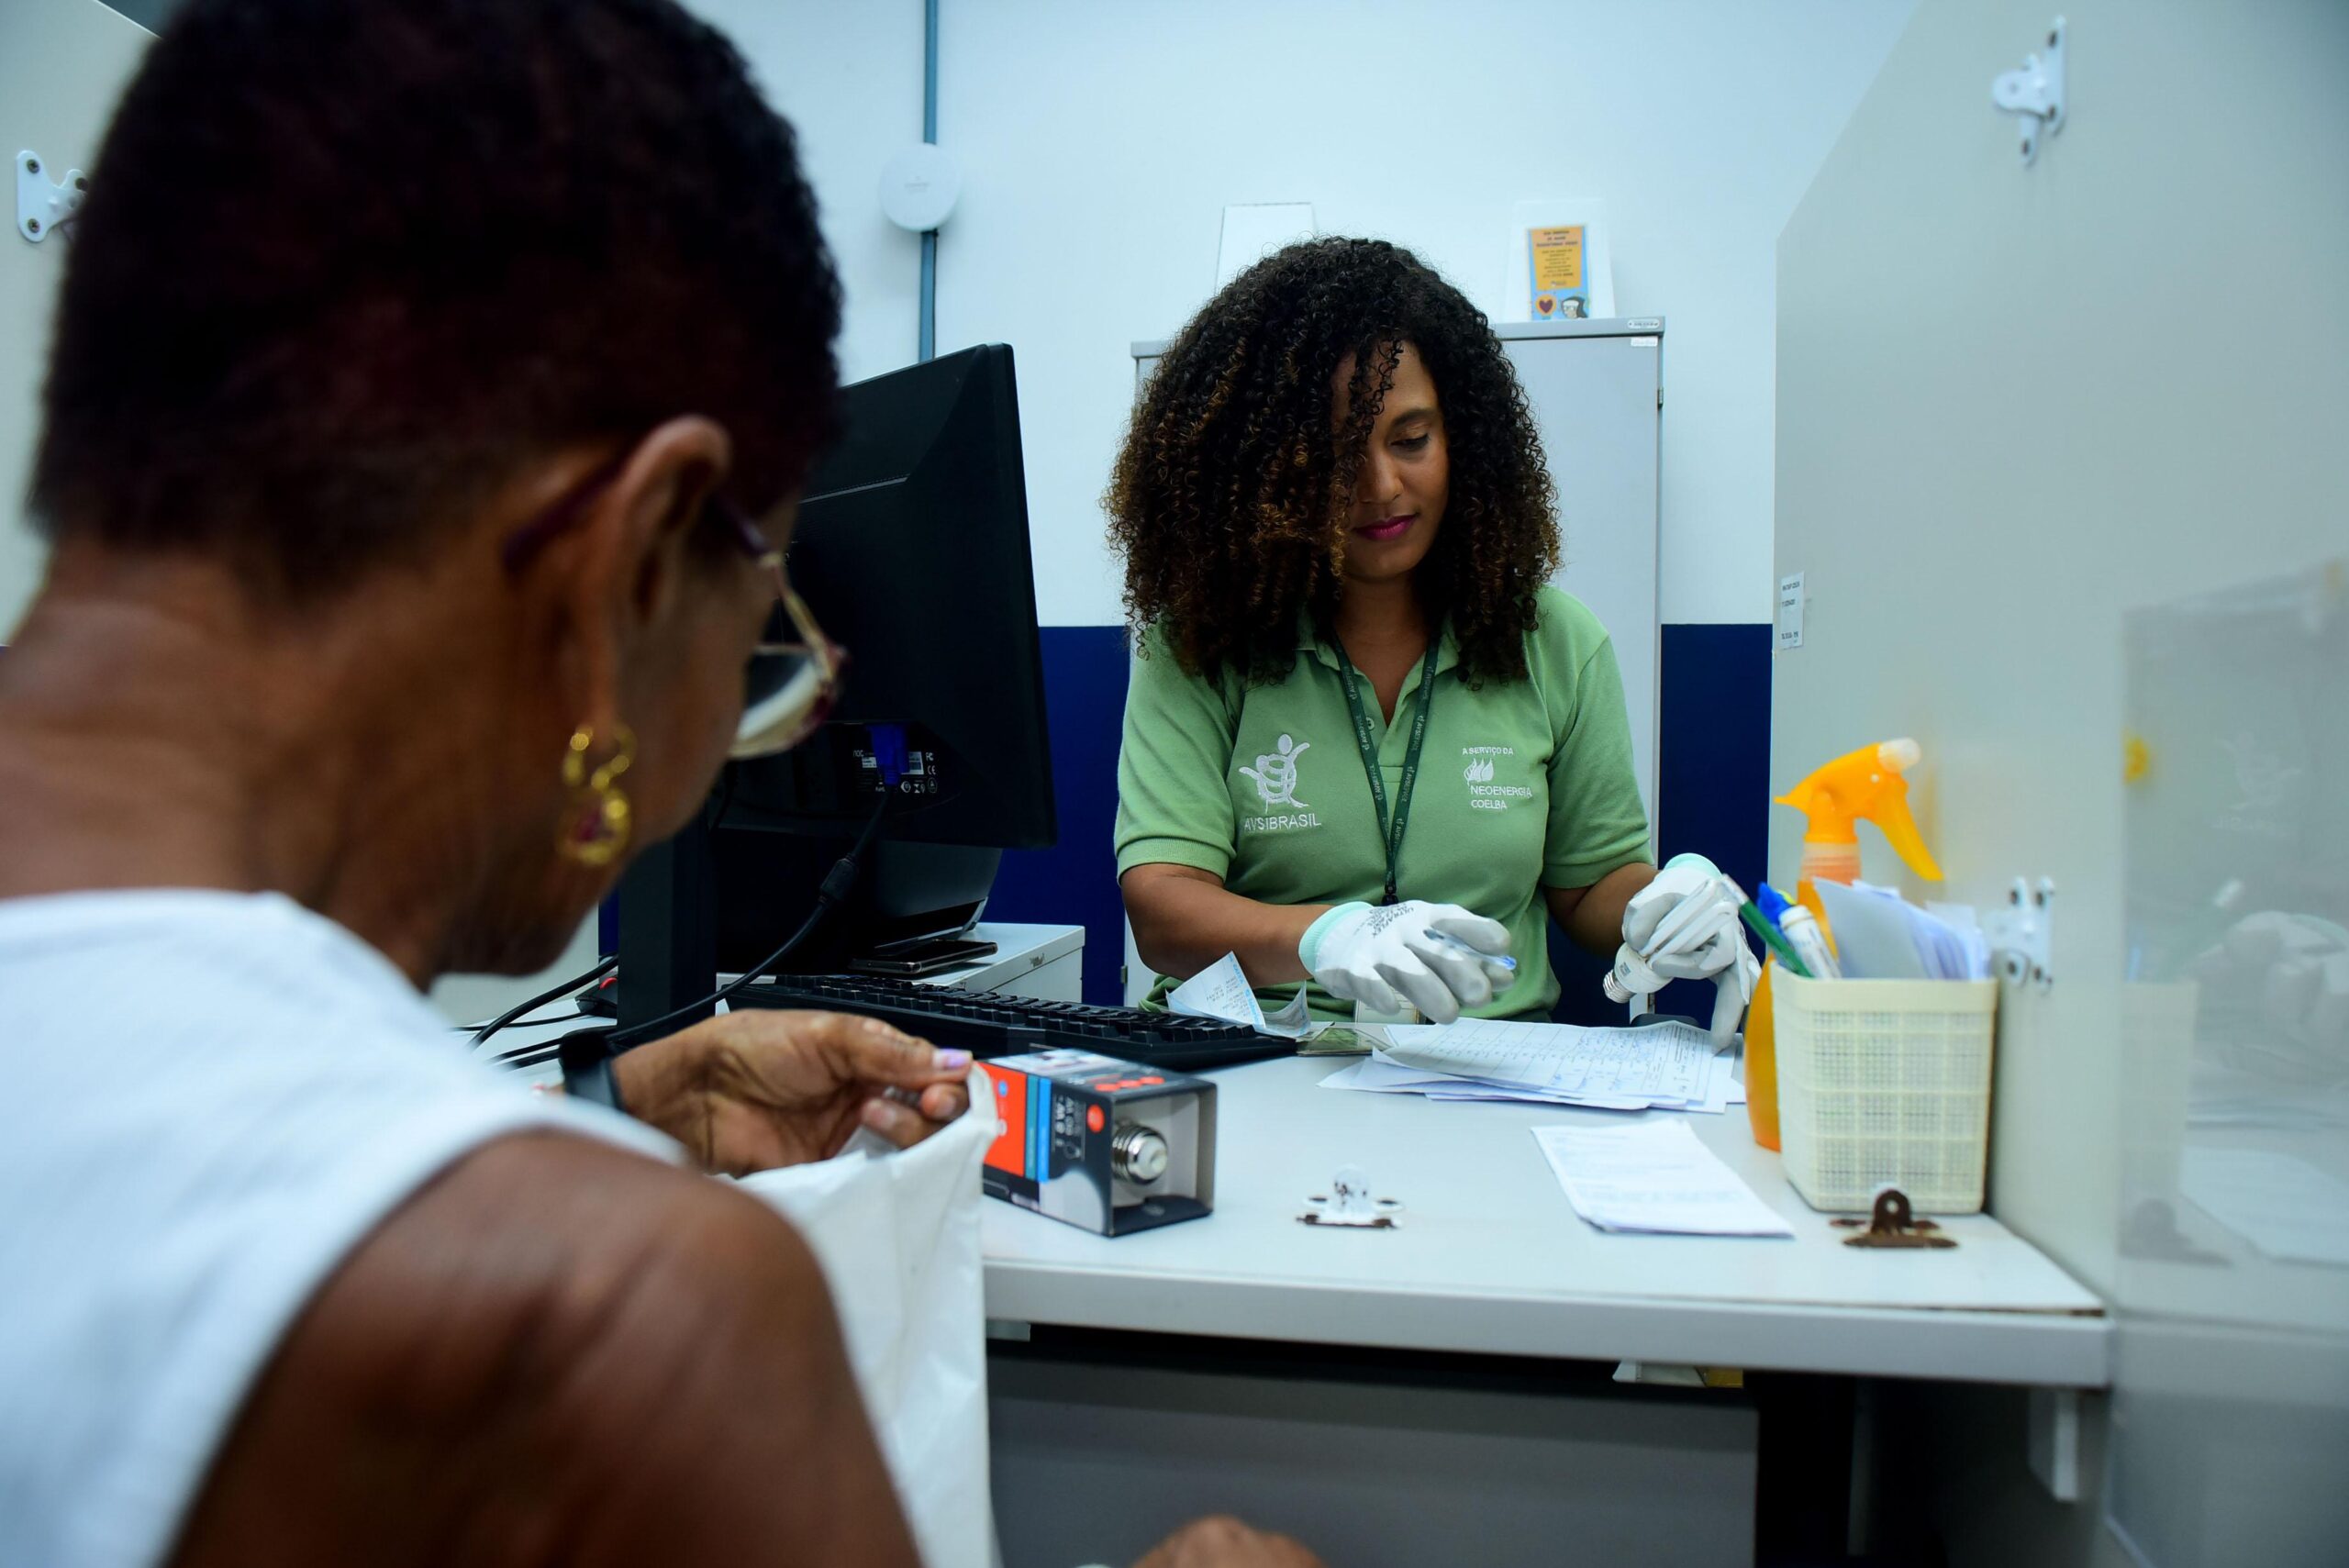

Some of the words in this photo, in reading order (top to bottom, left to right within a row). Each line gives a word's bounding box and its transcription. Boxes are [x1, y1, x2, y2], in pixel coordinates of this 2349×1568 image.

[1462, 747, 1468, 755] A
[1468, 746, 1502, 756] SERVIÇO
[1503, 747, 1513, 755] DA
[1470, 785, 1531, 798] NEOENERGIA
[1471, 800, 1507, 809] COELBA
